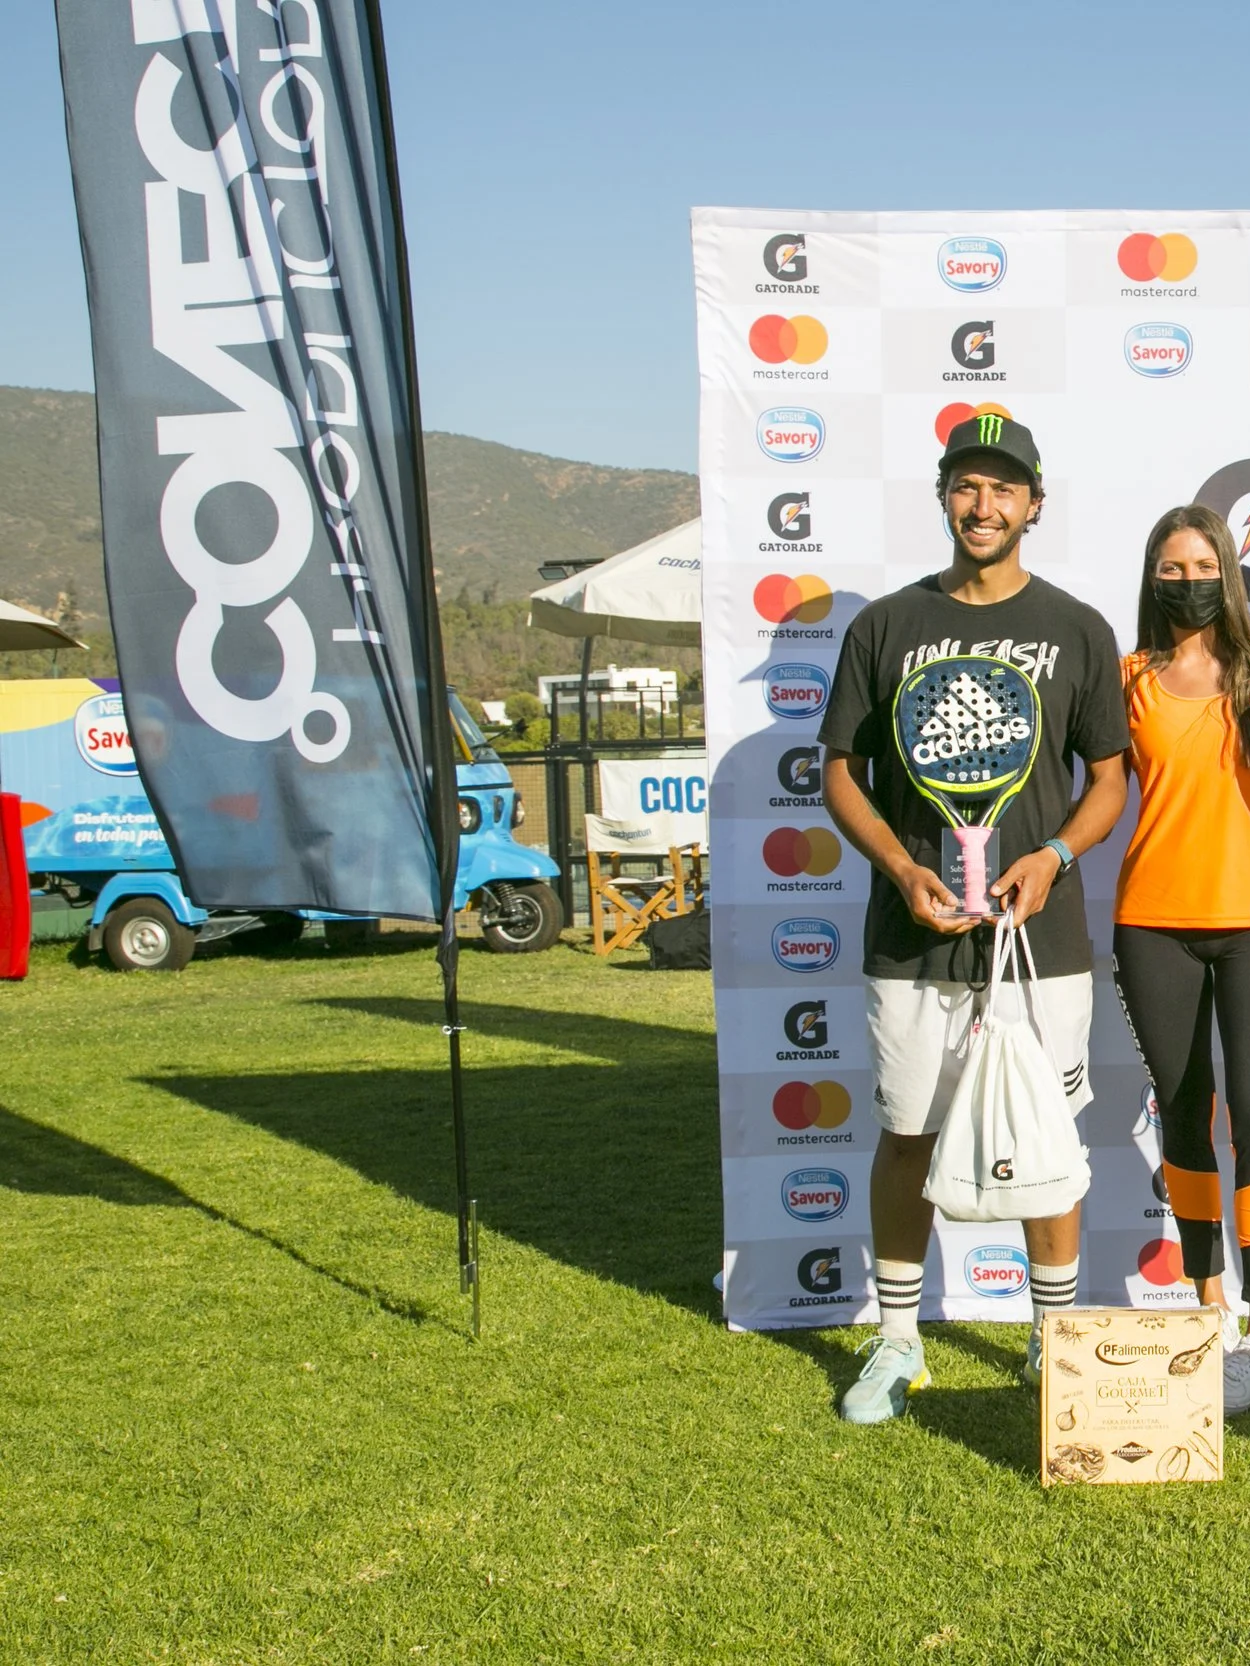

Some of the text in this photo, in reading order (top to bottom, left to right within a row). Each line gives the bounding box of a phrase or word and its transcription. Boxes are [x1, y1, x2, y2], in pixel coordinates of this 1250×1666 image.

[763, 234, 807, 282] G
[947, 260, 998, 276] Savory
[755, 284, 819, 294] GATORADE
[1121, 287, 1196, 296] mastercard
[951, 321, 994, 370] G
[1133, 346, 1184, 361] Savory
[754, 370, 828, 380] mastercard
[943, 373, 1006, 381] GATORADE
[765, 430, 816, 448] Savory
[768, 492, 811, 540] G
[759, 543, 822, 552] GATORADE
[758, 628, 832, 639] mastercard
[771, 685, 822, 704] Savory
[100, 701, 124, 715] Nes
[88, 728, 133, 750] Sav
[913, 717, 1031, 765] adidas
[778, 746, 821, 795] G
[769, 797, 825, 807] GATORAD
[767, 880, 842, 891] mastercard
[780, 940, 832, 957] Savory
[784, 1000, 828, 1049] G
[776, 1050, 839, 1060] GATORADE
[778, 1132, 852, 1145] mastercard
[789, 1188, 841, 1206] Savory
[1144, 1209, 1175, 1218] GATO
[798, 1247, 841, 1294] G
[973, 1267, 1023, 1284] Savory
[790, 1296, 853, 1307] GATORADE
[1143, 1290, 1198, 1301] masterc
[1117, 1377, 1147, 1387] CAJA
